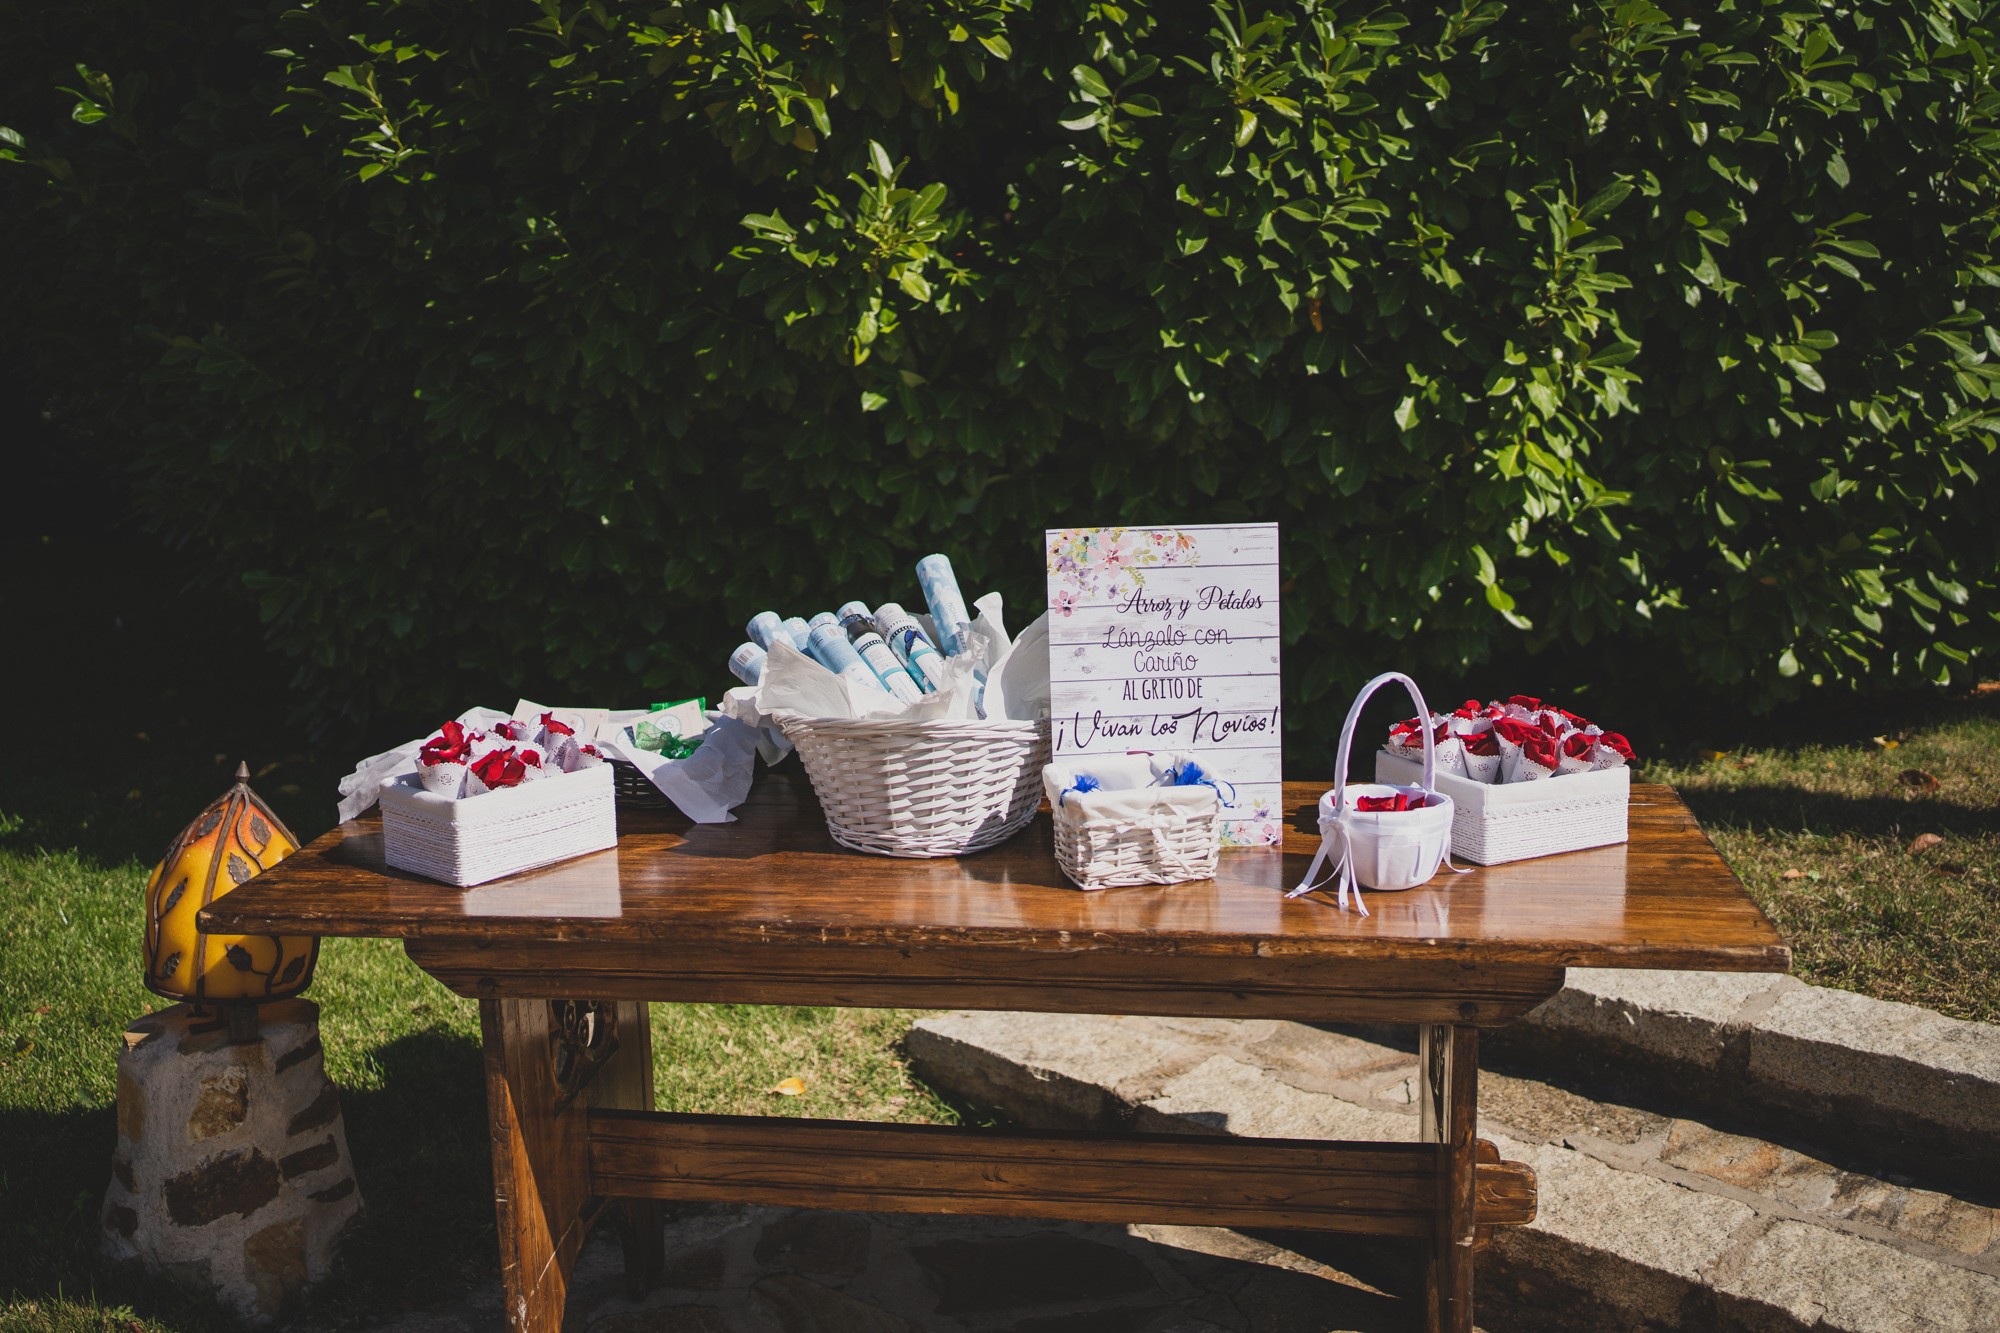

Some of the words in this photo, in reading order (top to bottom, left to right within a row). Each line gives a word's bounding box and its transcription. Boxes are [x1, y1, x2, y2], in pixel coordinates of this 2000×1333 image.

[1116, 587, 1175, 620] Arroz
[1178, 599, 1192, 620] y
[1102, 624, 1187, 652] Lánzalo
[1194, 628, 1233, 646] con
[1133, 650, 1199, 673] Cariño
[1122, 679, 1139, 701] AL
[1142, 677, 1184, 700] GRITO
[1187, 677, 1203, 699] DE
[1151, 714, 1178, 736] los
